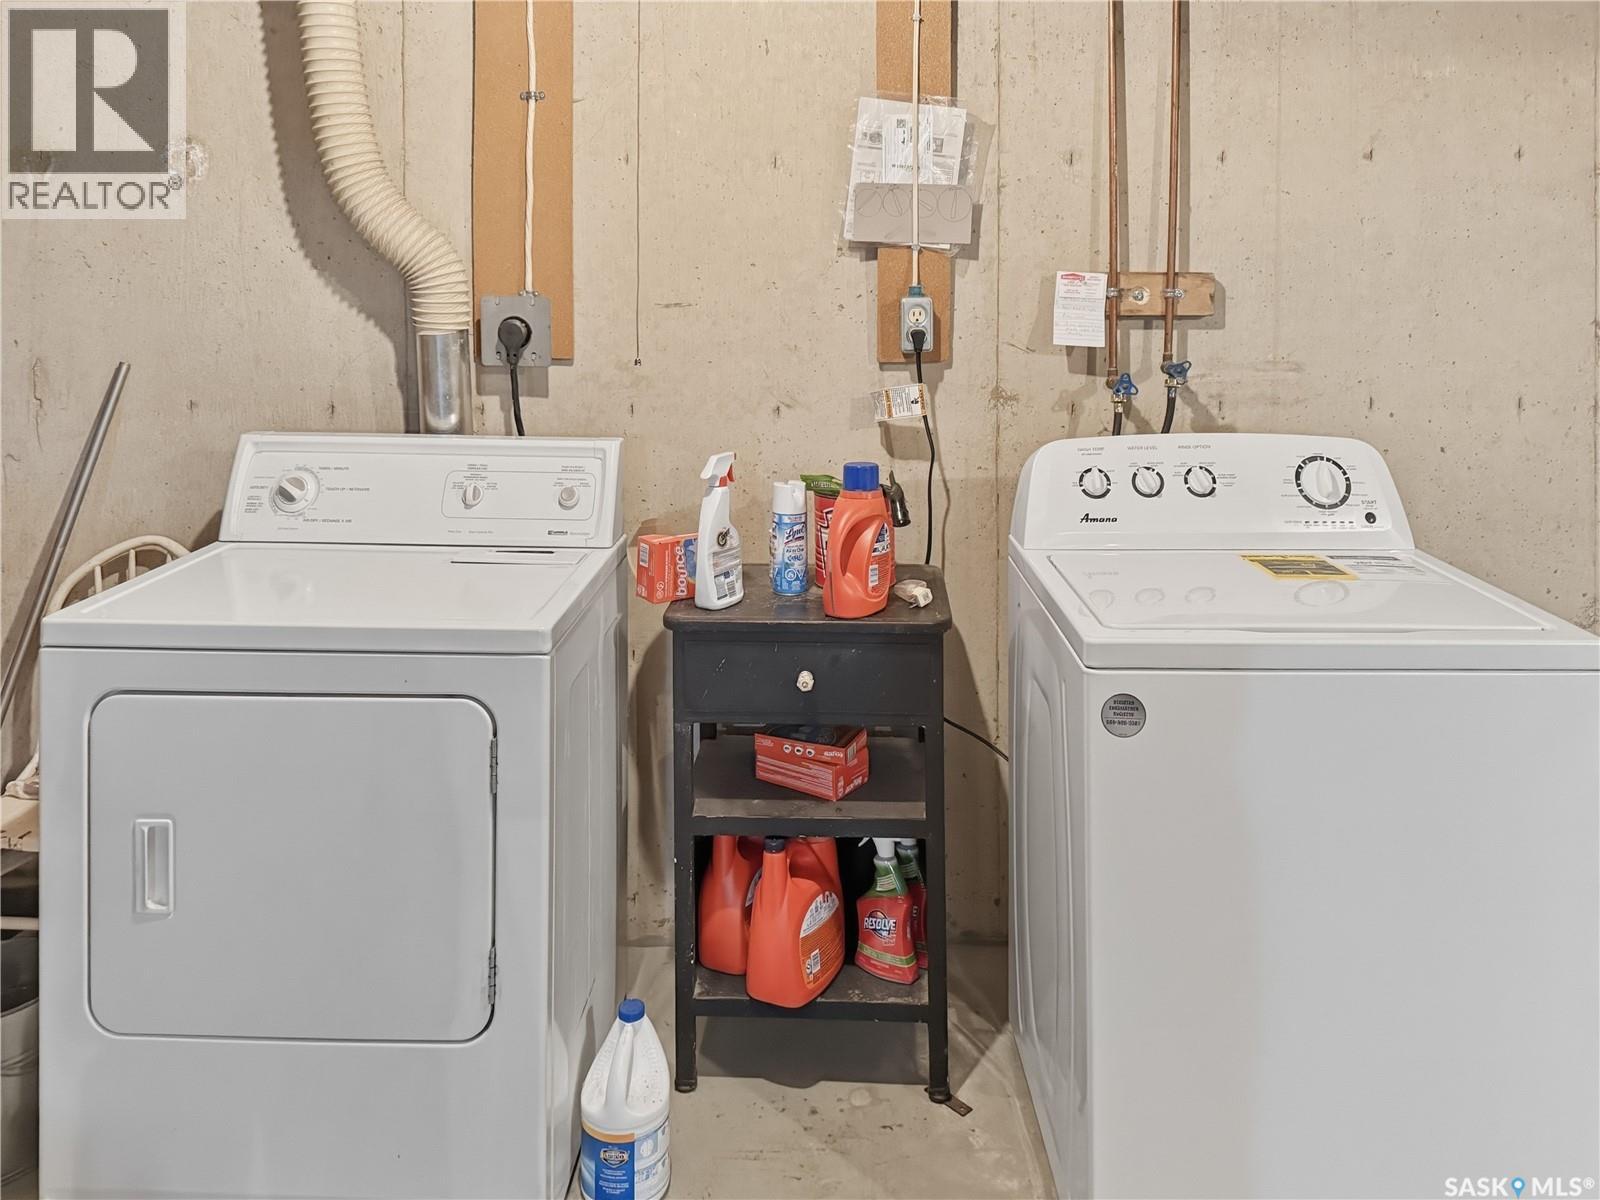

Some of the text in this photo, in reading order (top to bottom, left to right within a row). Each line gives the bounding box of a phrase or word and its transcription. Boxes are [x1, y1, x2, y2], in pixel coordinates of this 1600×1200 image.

[1080, 513, 1118, 523] Amana
[675, 546, 687, 596] bounce
[864, 917, 897, 930] RESOLVE
